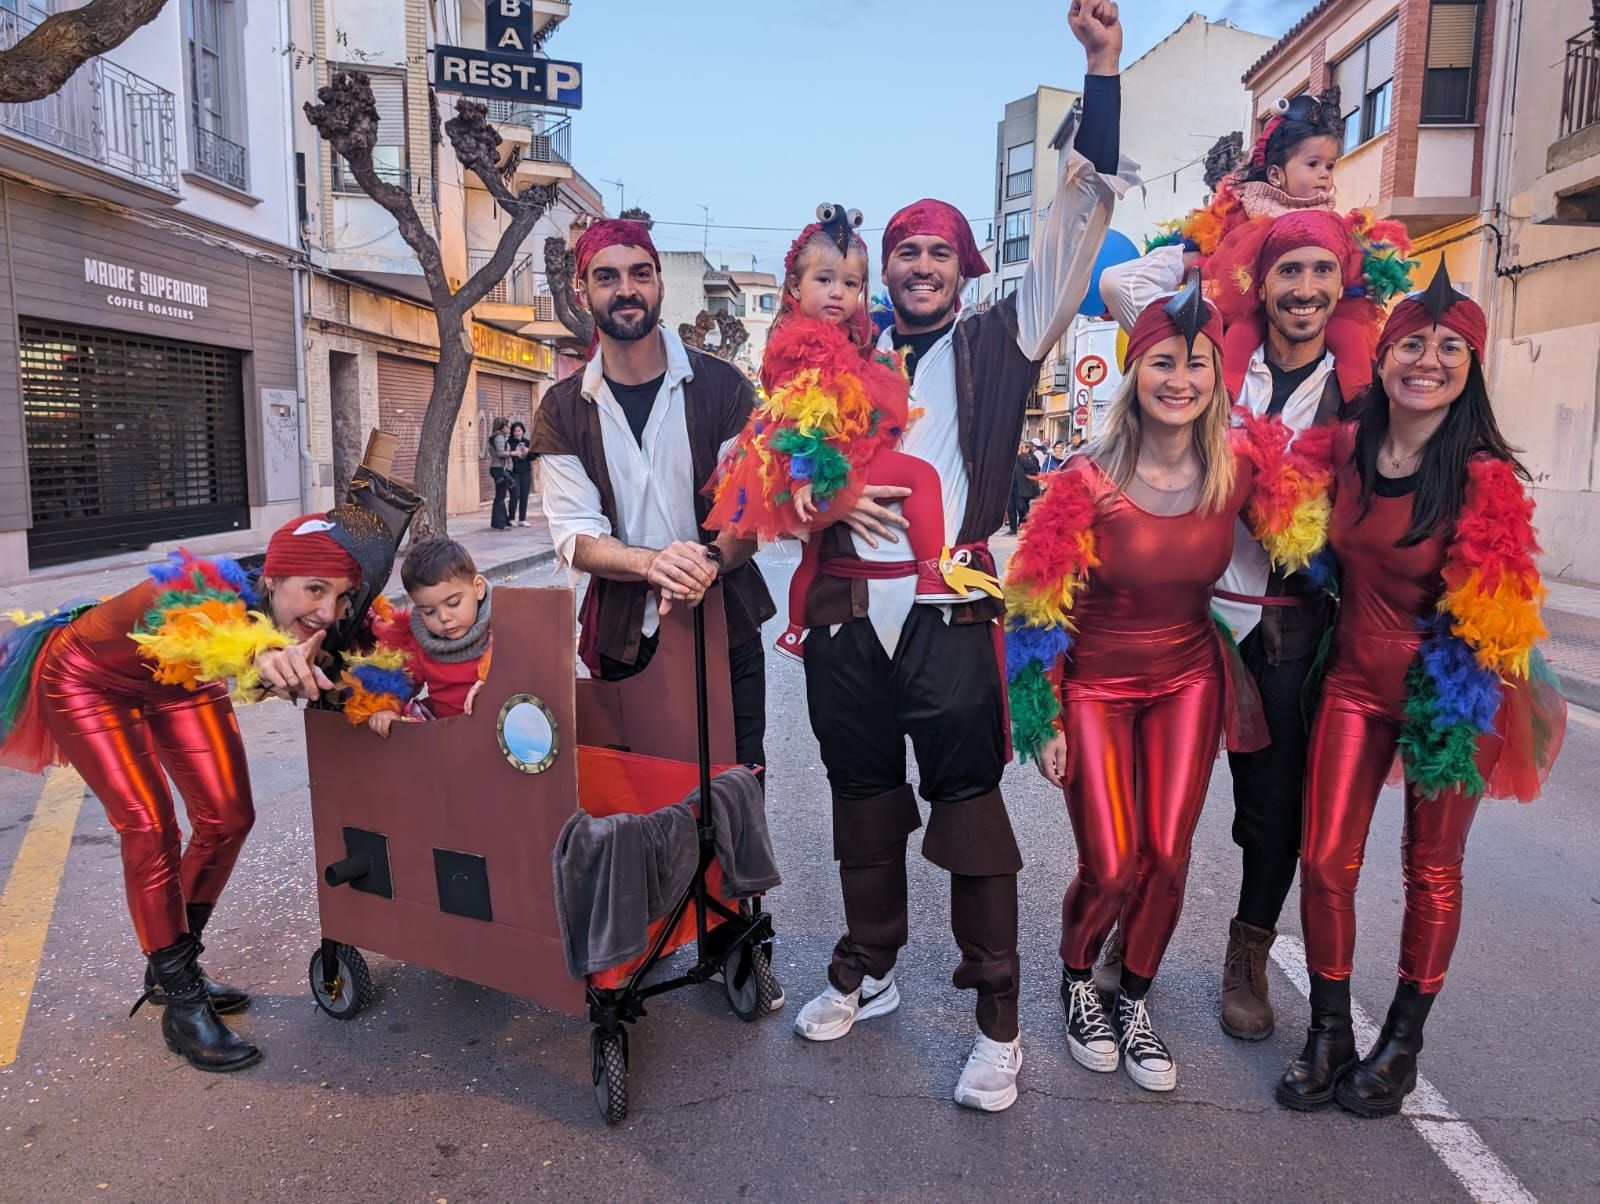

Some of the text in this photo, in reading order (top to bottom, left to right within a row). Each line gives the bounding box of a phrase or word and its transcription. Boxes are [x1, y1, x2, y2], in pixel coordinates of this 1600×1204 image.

[443, 55, 581, 101] REST. P
[84, 257, 208, 308] MADRE SUPERIORA
[106, 294, 194, 321] COFFEE ROASTERS
